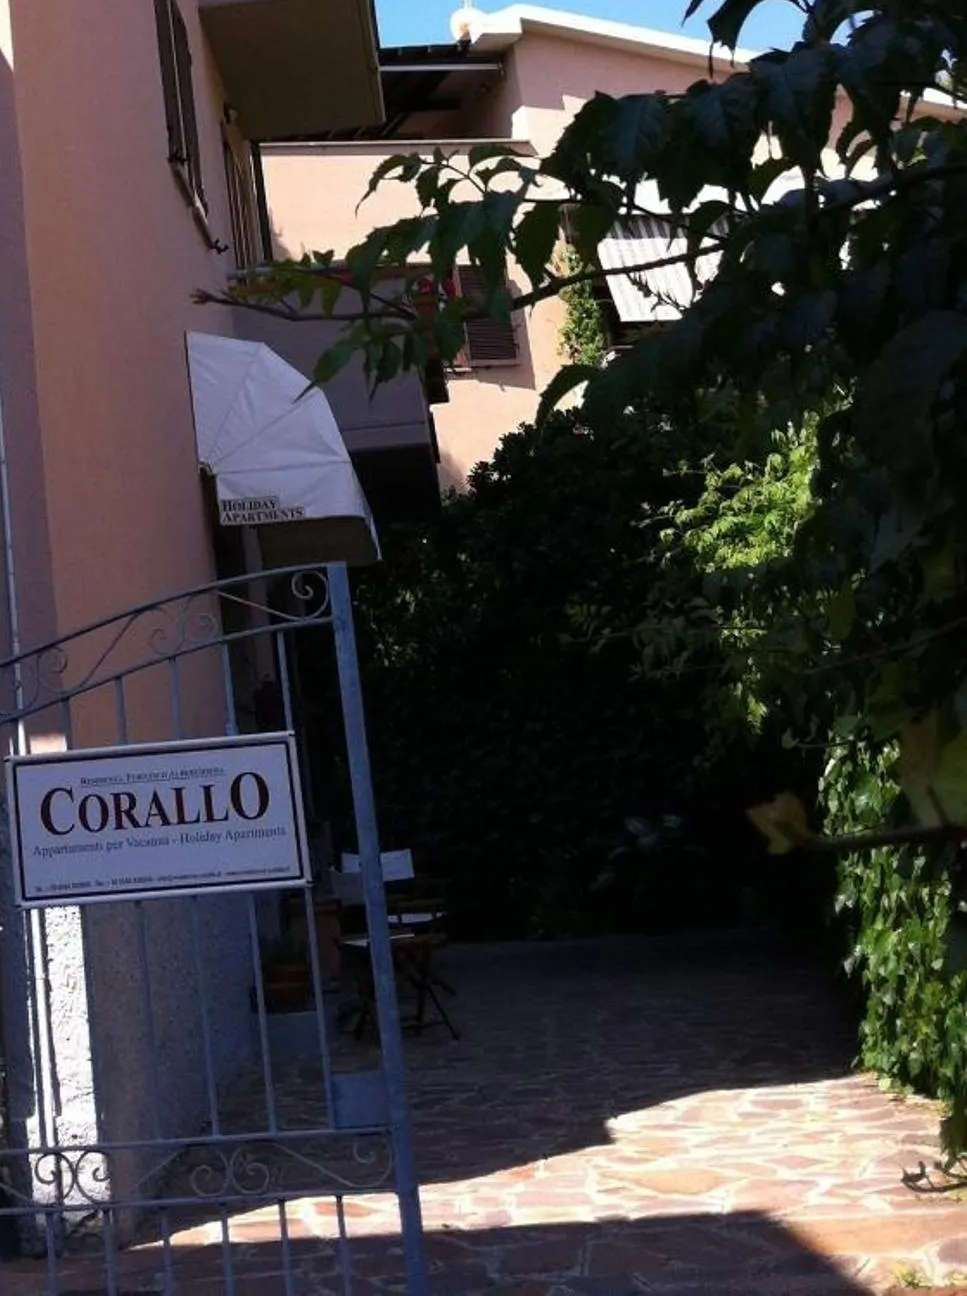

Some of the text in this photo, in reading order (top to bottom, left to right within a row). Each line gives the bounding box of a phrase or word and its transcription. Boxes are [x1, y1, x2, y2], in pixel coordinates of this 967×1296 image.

[222, 499, 276, 512] HOLIDAY
[222, 507, 303, 522] APARTMENTS
[40, 772, 269, 835] CORALLO
[180, 831, 222, 844] Holiday
[226, 825, 286, 842] Apartments
